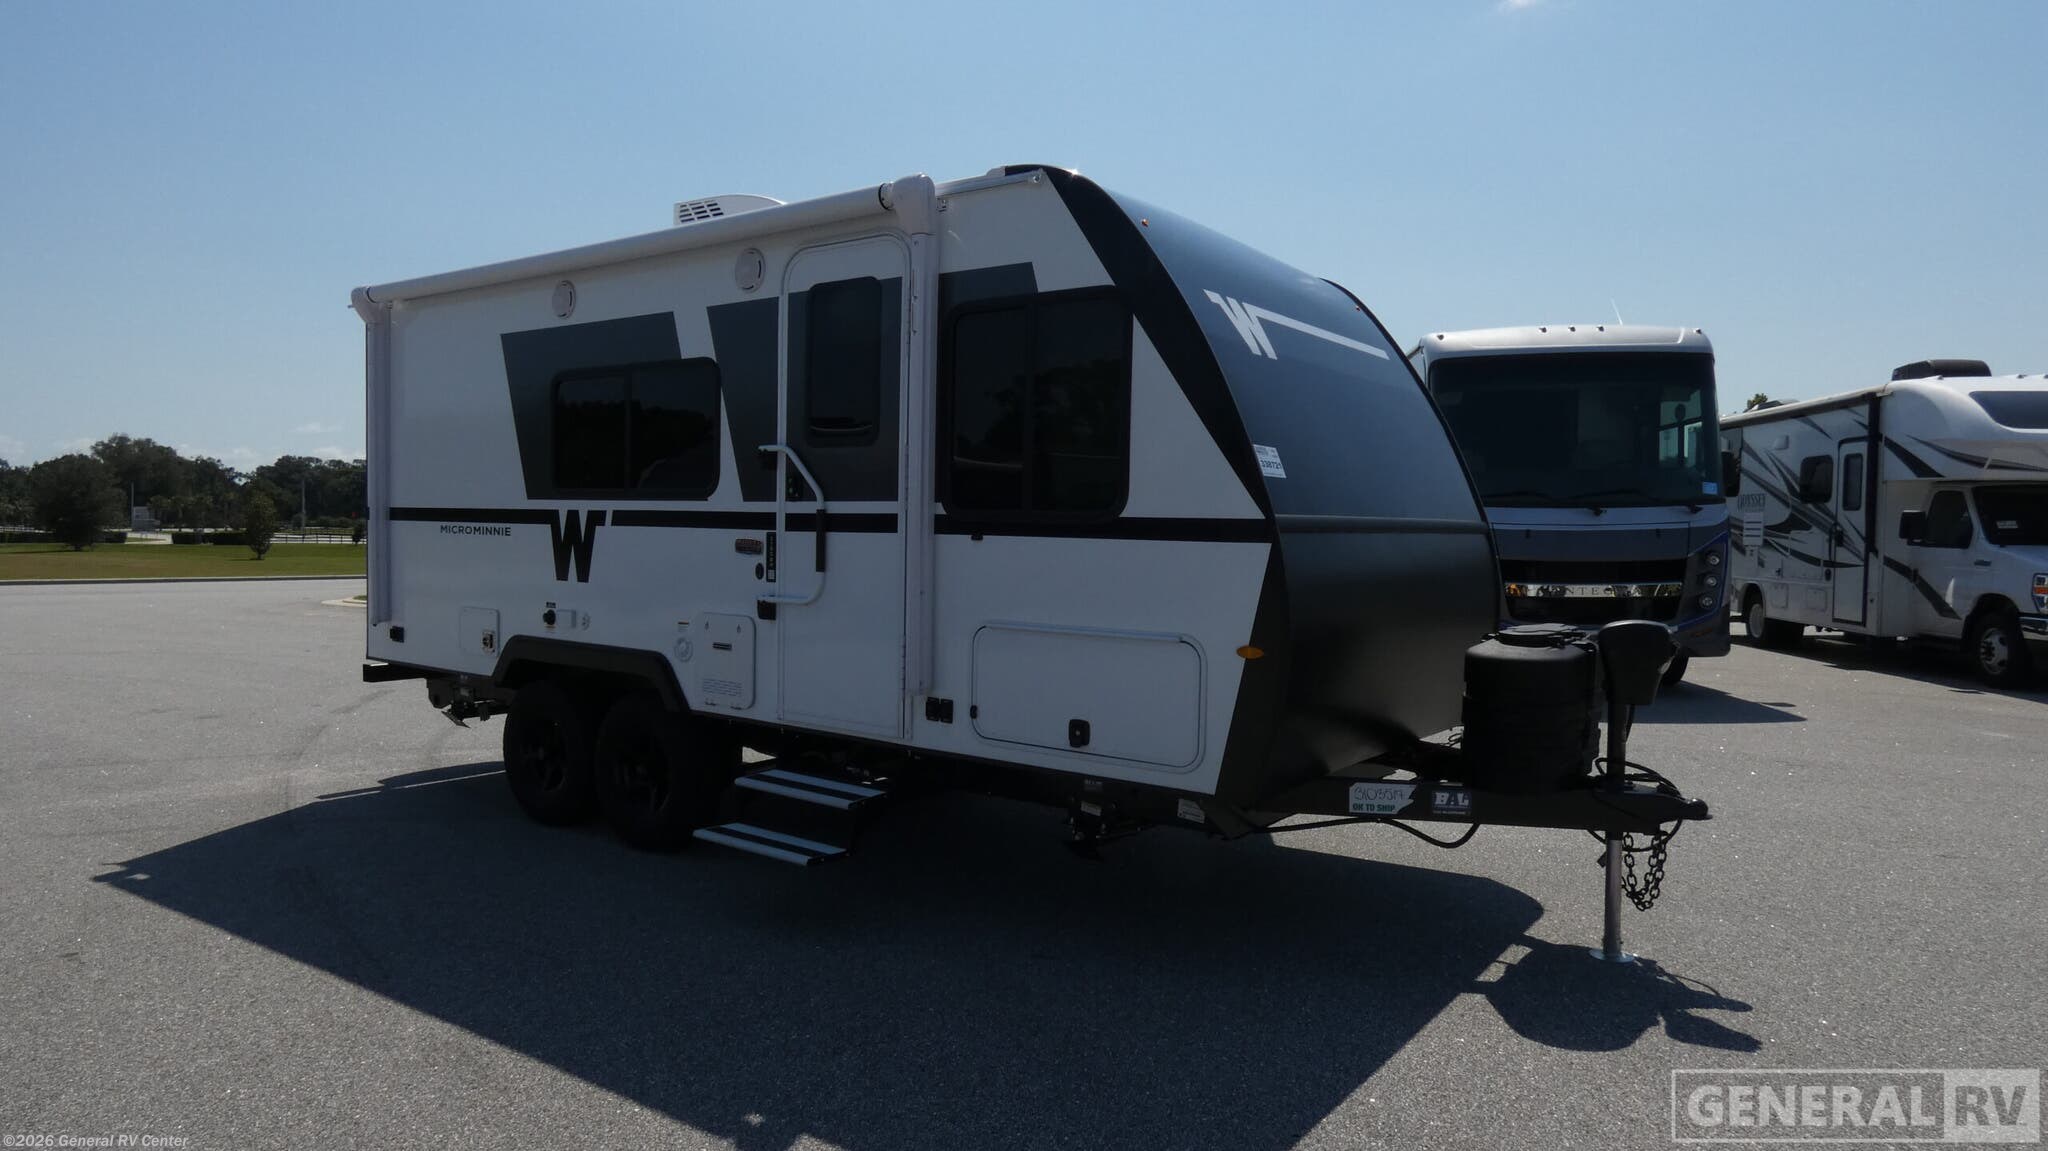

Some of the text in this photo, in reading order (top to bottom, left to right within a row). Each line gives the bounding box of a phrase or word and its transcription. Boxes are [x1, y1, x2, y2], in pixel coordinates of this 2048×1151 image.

[440, 524, 512, 537] MICROMINNIE
[1435, 792, 1470, 806] BAL
[1352, 803, 1364, 811] OK
[1366, 803, 1375, 812] TO
